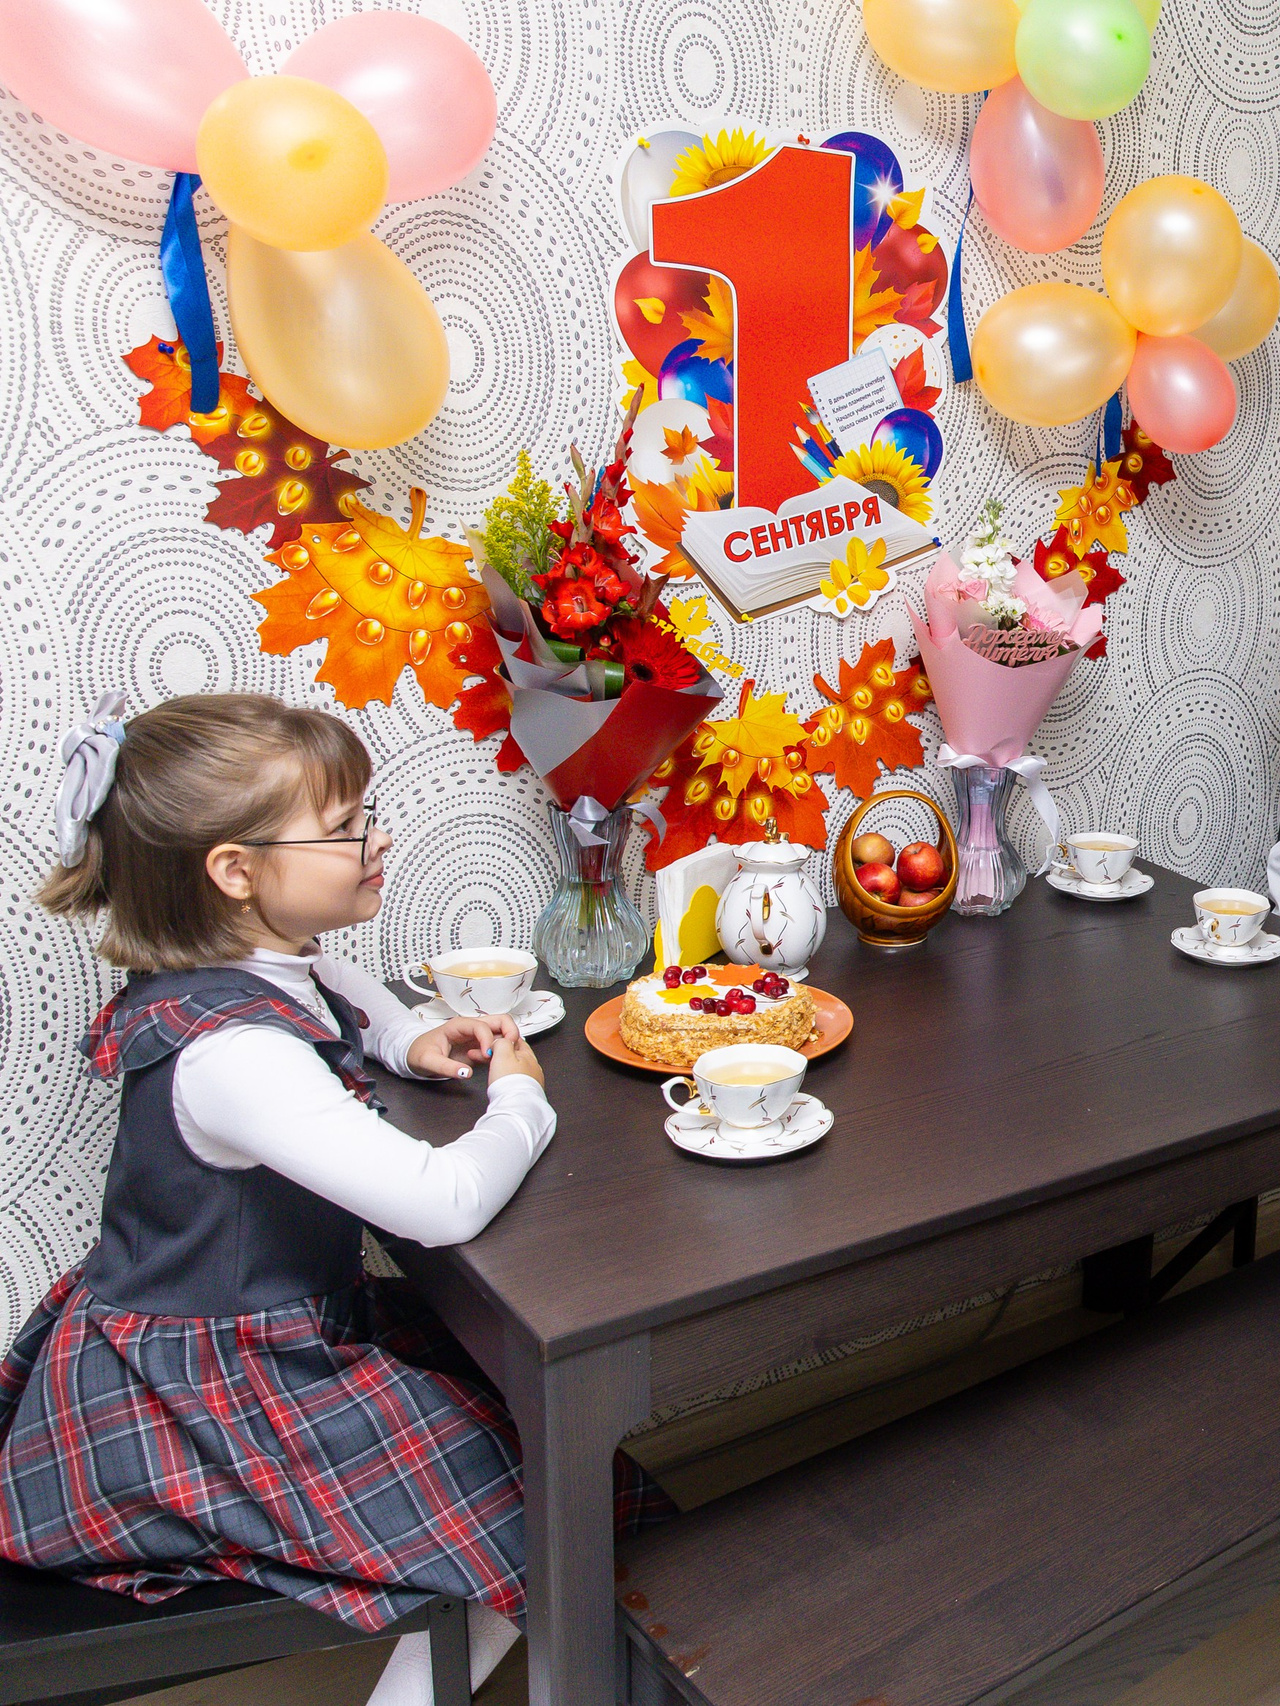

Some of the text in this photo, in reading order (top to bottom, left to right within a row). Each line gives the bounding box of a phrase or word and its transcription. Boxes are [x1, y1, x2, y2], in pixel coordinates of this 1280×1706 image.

[652, 146, 854, 516] 1
[832, 385, 886, 414] Клёны пламенем горят!
[833, 394, 845, 403] день
[845, 384, 865, 399] весёлый
[865, 375, 886, 389] сентября
[835, 396, 886, 423] Начался учебный год!
[839, 420, 855, 432] Школа
[855, 415, 869, 425] снова
[872, 407, 885, 417] гости
[885, 400, 899, 411] ждёт!
[723, 495, 882, 563] СЕНТЯБРЯ
[687, 604, 700, 622] 1
